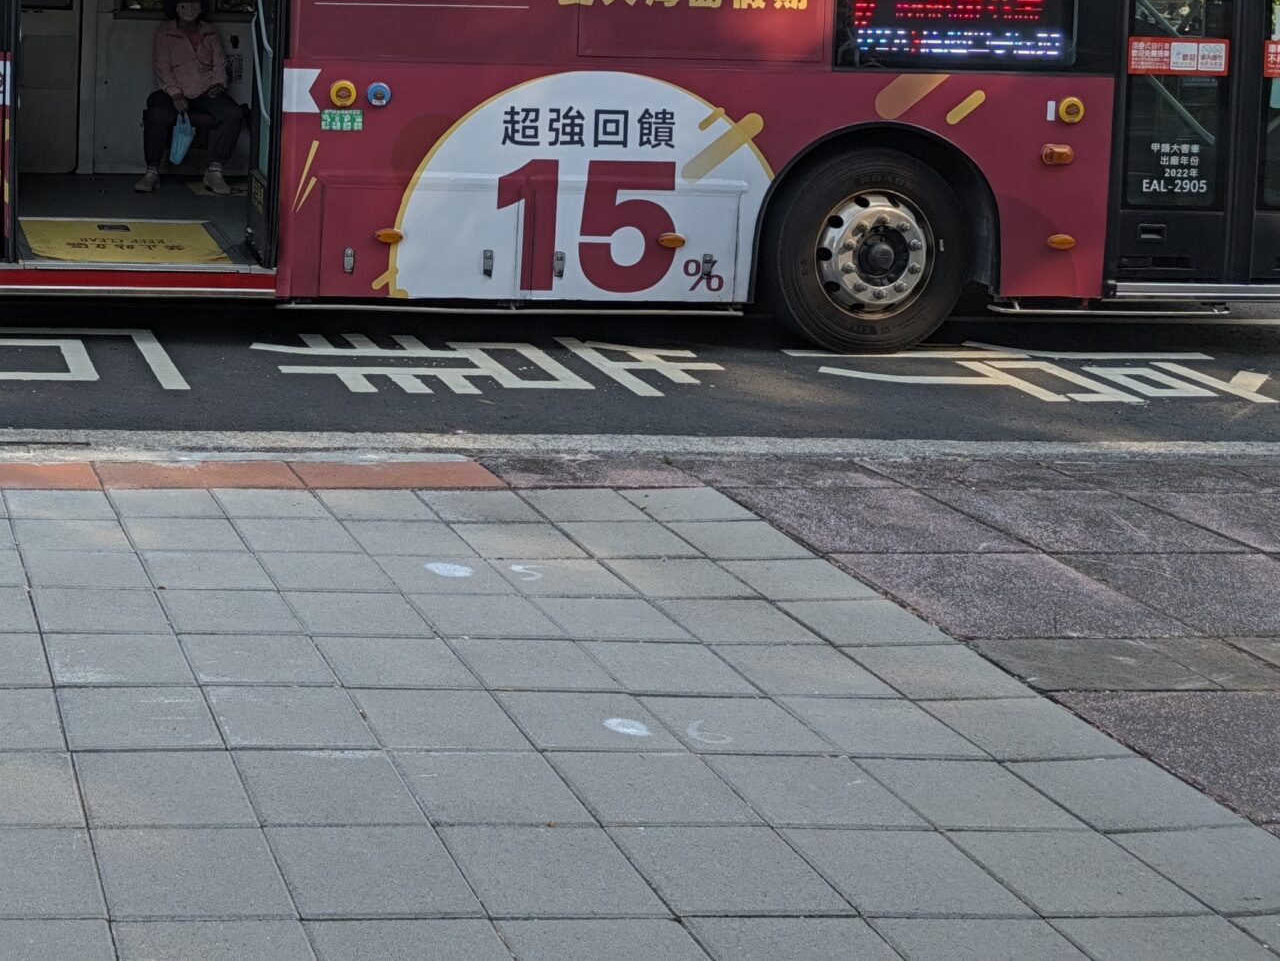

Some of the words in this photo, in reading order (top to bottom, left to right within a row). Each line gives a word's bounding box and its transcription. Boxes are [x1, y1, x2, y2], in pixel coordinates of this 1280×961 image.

[501, 105, 677, 150] 超強回饋
[1151, 142, 1201, 154] 甲類大客車
[1160, 155, 1200, 166] 出廠年份
[1164, 168, 1199, 178] 2022年
[1142, 179, 1208, 193] EAL-2905
